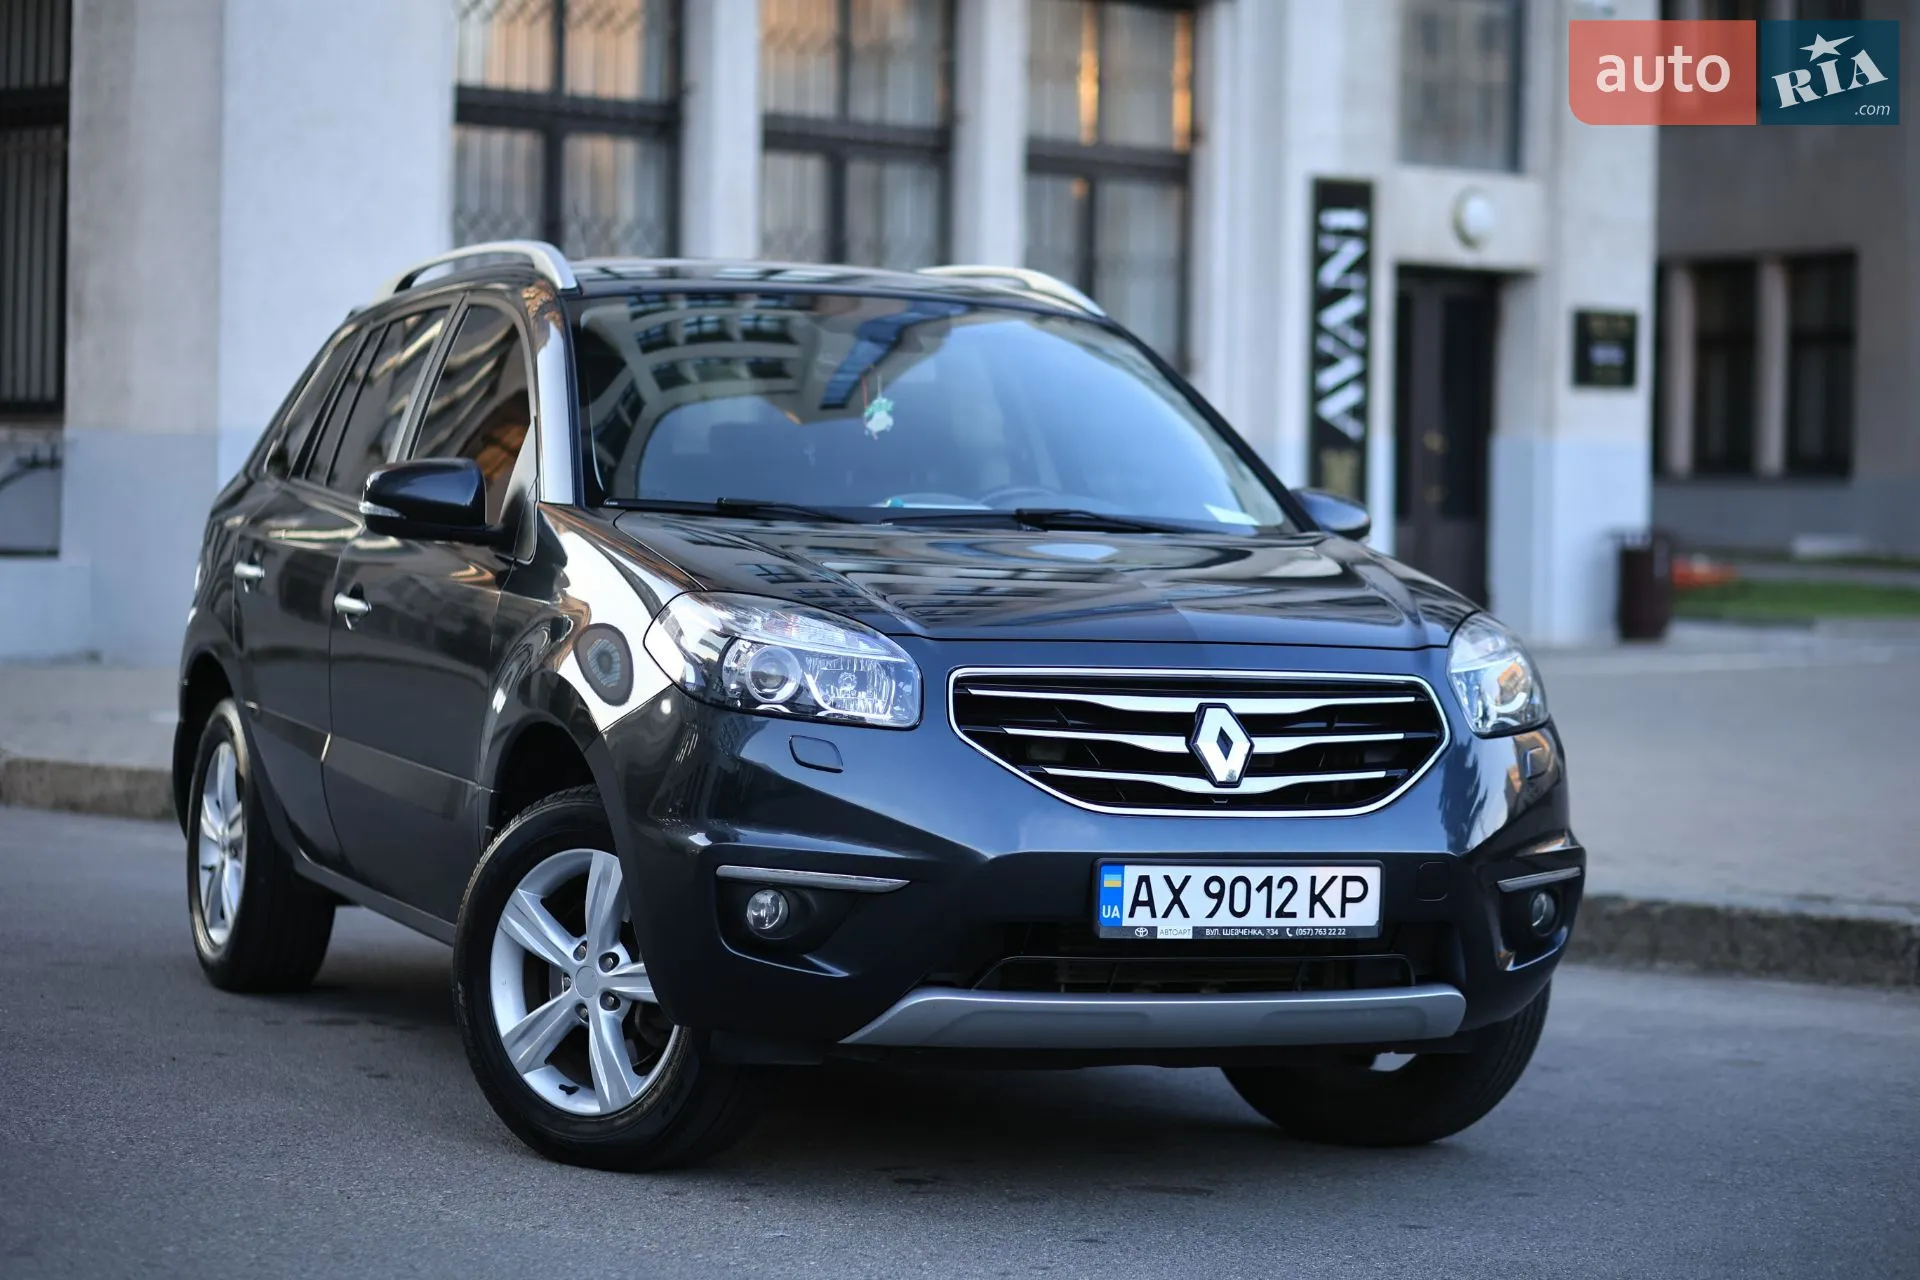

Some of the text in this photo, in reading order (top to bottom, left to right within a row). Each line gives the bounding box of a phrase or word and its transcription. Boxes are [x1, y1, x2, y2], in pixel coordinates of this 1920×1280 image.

[1315, 207, 1367, 442] AVANI
[1128, 875, 1369, 919] AX 9012 KP
[1102, 905, 1121, 918] UA
[1160, 928, 1192, 936] АВТОАРТ
[1205, 928, 1221, 936] ВУЛ.
[1295, 928, 1314, 937] (057)
[1314, 928, 1327, 936] 763
[1328, 928, 1337, 936] 22
[1337, 928, 1346, 936] 22
